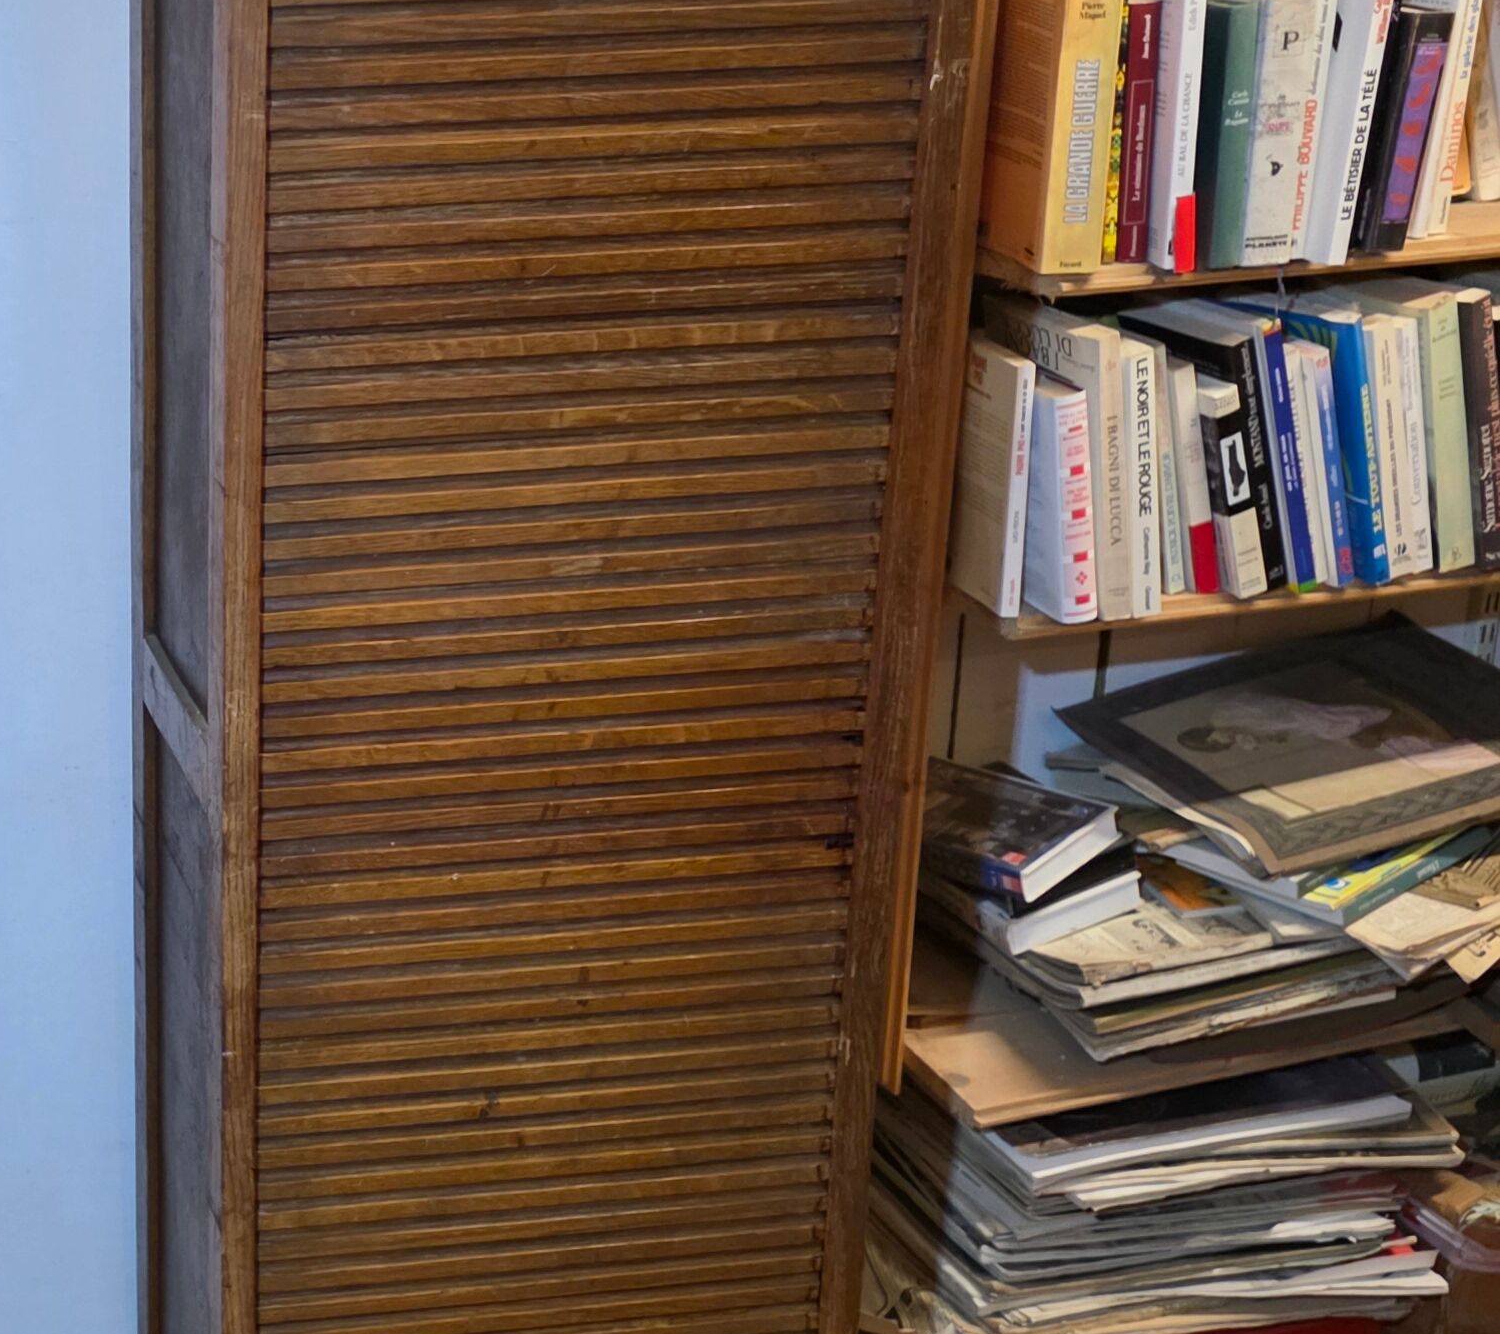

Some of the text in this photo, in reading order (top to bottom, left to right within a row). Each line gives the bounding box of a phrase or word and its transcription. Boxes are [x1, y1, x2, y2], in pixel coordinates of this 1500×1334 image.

[1182, 72, 1194, 113] CHANCE
[1360, 68, 1377, 100] TÉLÉ
[1296, 98, 1318, 165] BOUVARD
[1354, 126, 1368, 144] DE
[1358, 104, 1371, 122] LA
[1062, 58, 1101, 224] LA GRANDE GUERRE
[1439, 100, 1465, 184] Daninos
[1340, 205, 1353, 221] LE
[1107, 424, 1120, 472] BAGNI
[1135, 357, 1152, 517] LE NOIR ET LE ROUGE
[1109, 476, 1121, 492] DI
[1406, 421, 1422, 506] Conversation
[1109, 496, 1123, 547] LUCCA
